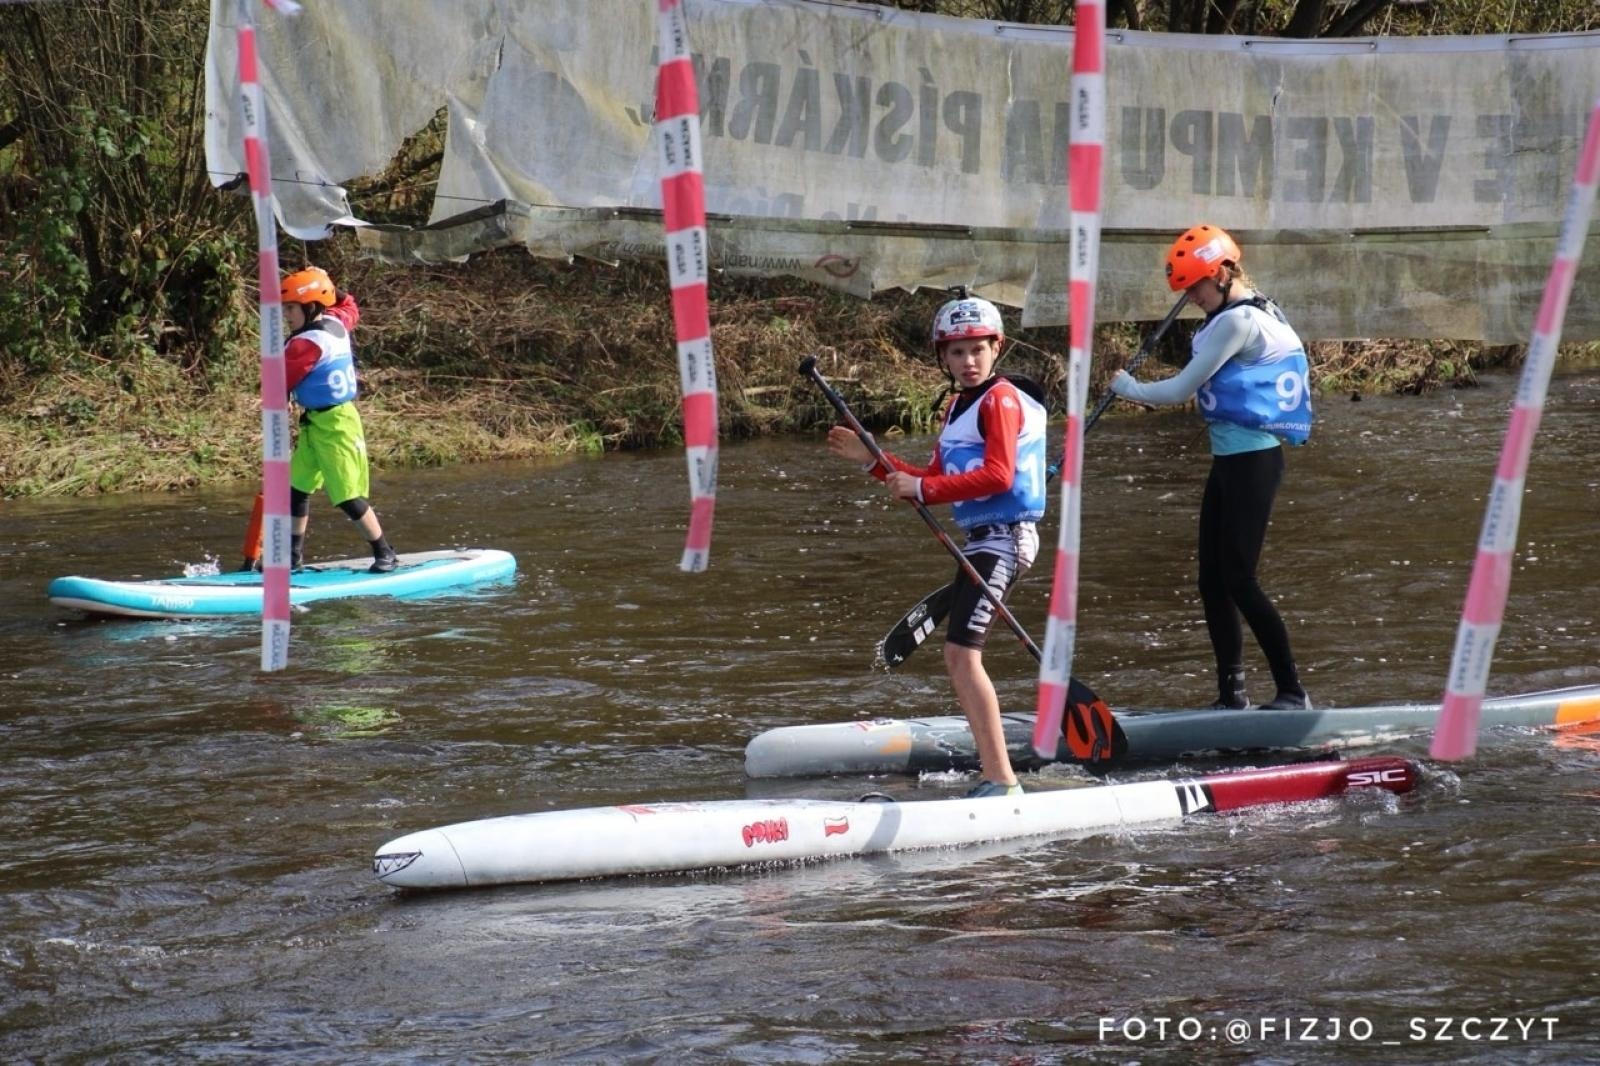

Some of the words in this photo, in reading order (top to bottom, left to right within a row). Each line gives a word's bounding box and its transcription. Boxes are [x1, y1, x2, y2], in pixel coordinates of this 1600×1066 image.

[1077, 88, 1090, 131] VSTUP
[663, 132, 676, 166] VSTUP
[675, 243, 687, 277] VSTUP
[1346, 768, 1407, 787] SIC
